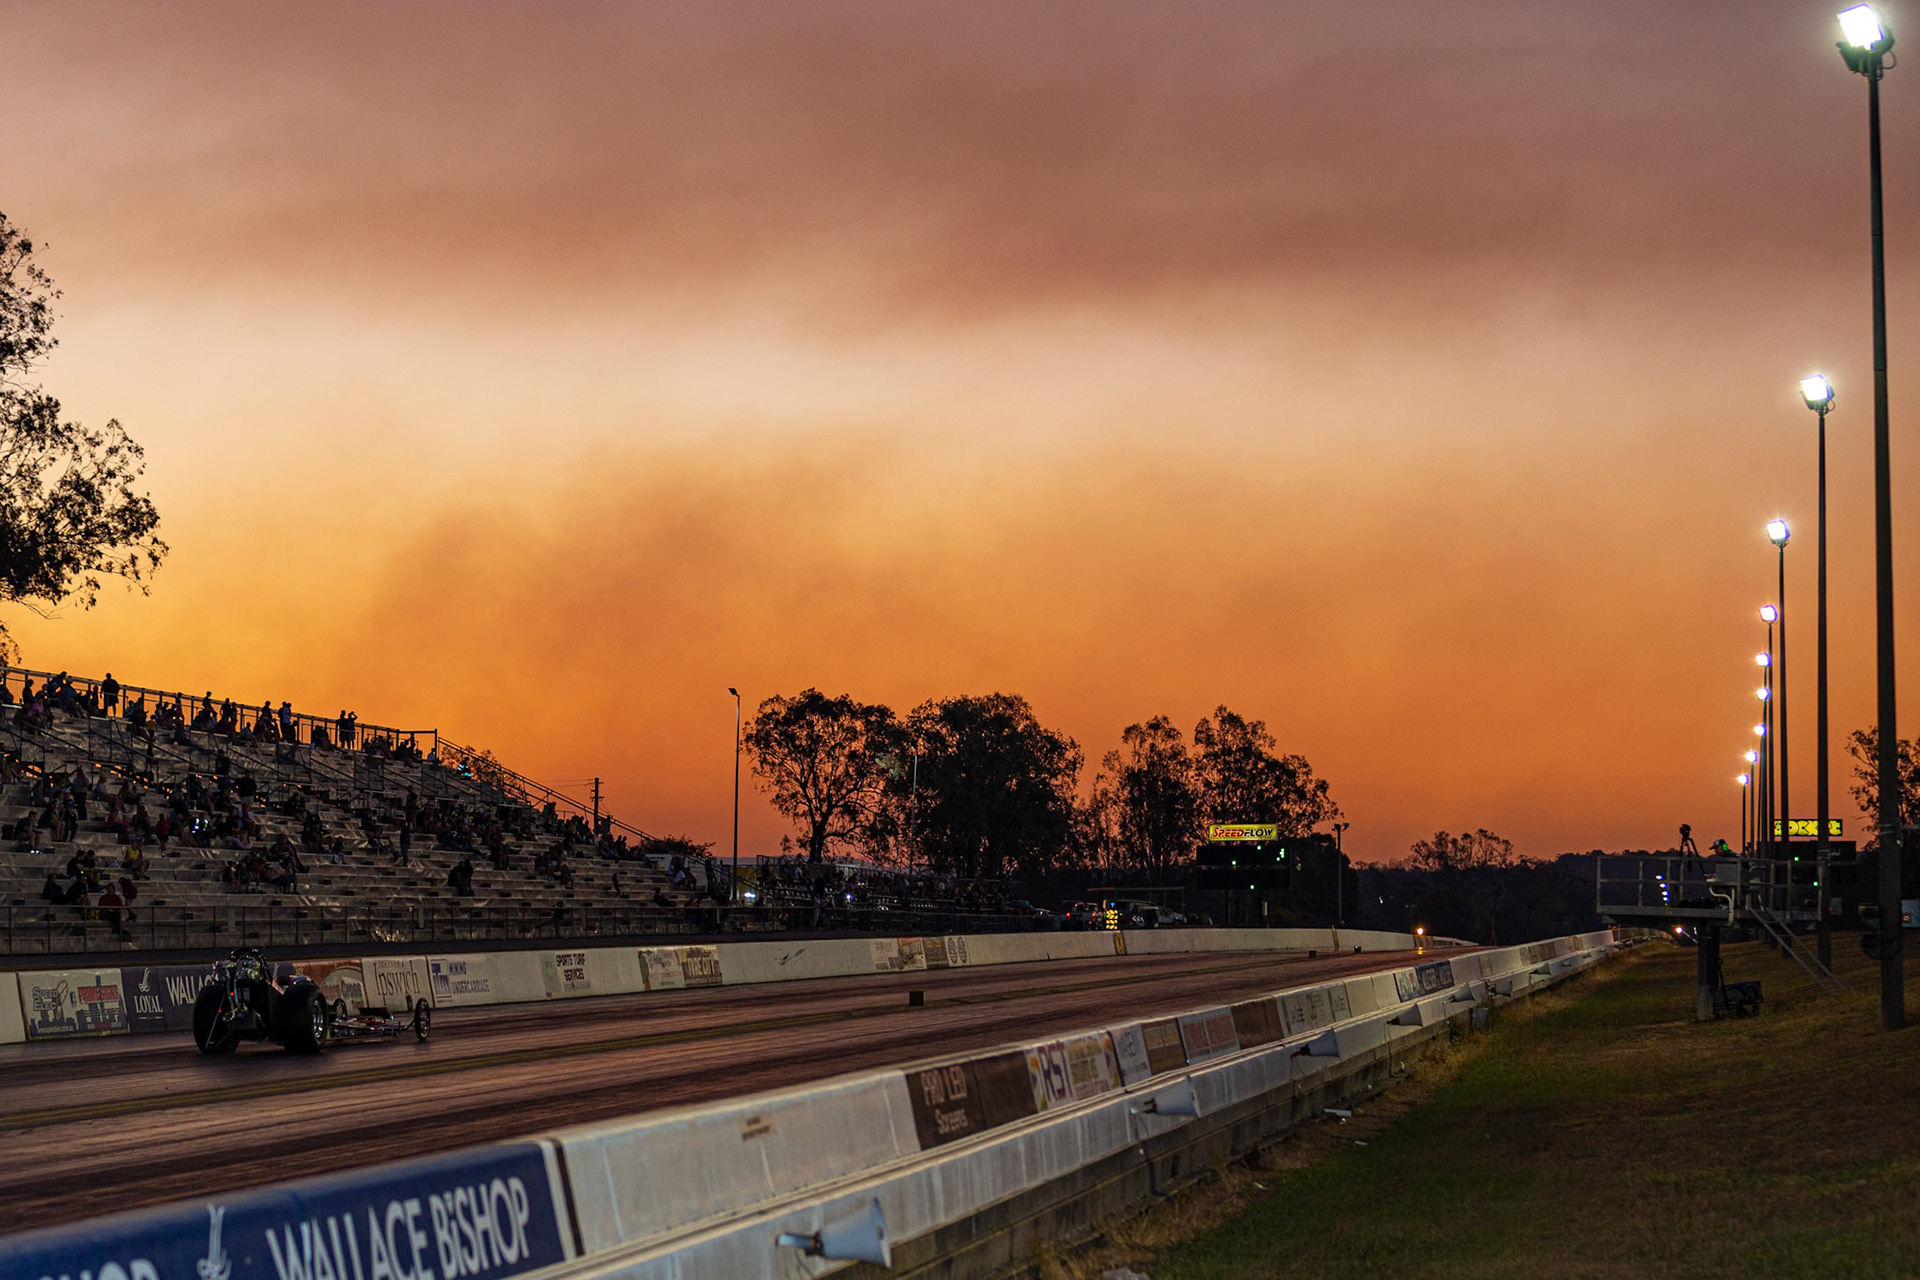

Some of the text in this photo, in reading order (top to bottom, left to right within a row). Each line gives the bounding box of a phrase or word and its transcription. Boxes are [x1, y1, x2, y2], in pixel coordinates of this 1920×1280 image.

[1212, 827, 1274, 838] SPEEDFLOW
[372, 960, 421, 1006] Ipswich
[32, 986, 59, 1000] SPEED
[33, 999, 57, 1011] ELEC
[133, 995, 164, 1013] LOYAL
